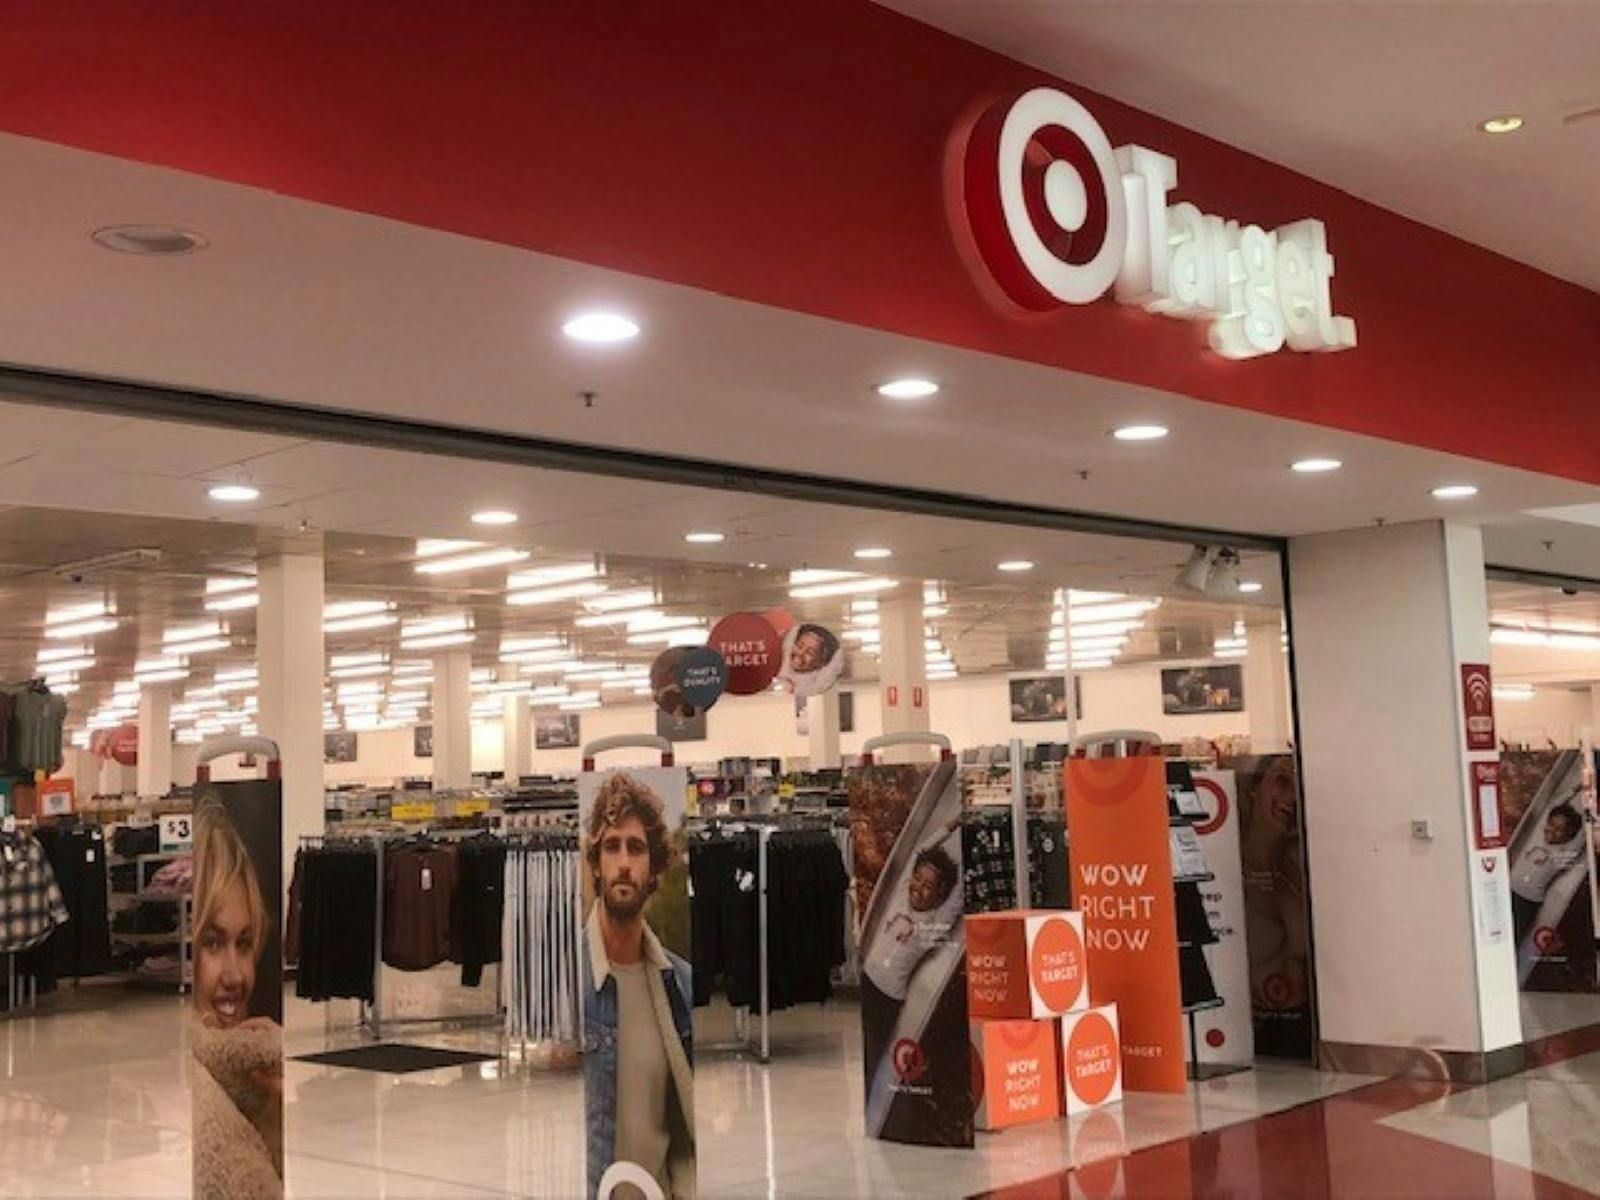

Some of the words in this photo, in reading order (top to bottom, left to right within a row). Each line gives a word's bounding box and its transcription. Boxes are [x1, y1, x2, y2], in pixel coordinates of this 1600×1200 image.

[719, 641, 765, 653] THAT'S
[726, 654, 769, 666] ARGET
[166, 820, 190, 838] $3
[1079, 863, 1149, 886] WOW
[1079, 896, 1155, 920] RIGHT
[1086, 928, 1150, 951] NOW
[968, 954, 1007, 967] WOW
[1041, 951, 1076, 966] THAT'S
[969, 971, 1009, 985] RIGHT
[1041, 966, 1079, 983] TARGET
[974, 988, 1007, 1002] NOW
[1077, 1044, 1109, 1062] THAT'S
[1006, 1058, 1039, 1075] WOW
[1075, 1059, 1112, 1078] TARGET
[1004, 1075, 1041, 1092] RIGHT
[1009, 1094, 1040, 1111] NOW
